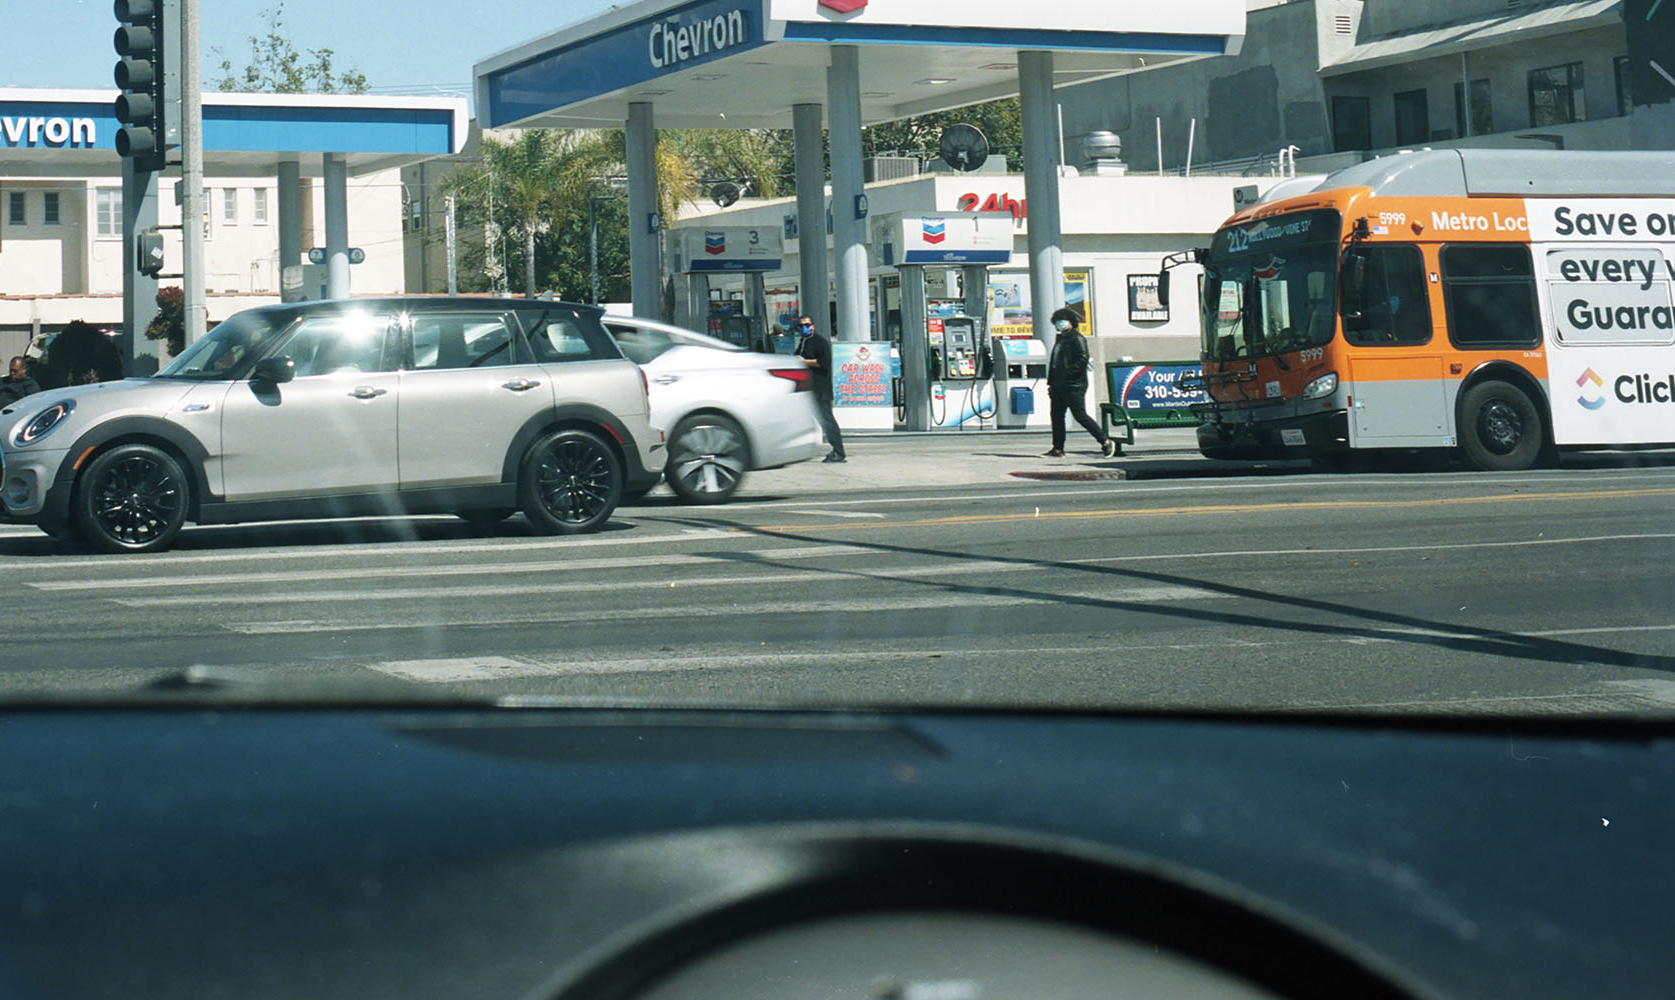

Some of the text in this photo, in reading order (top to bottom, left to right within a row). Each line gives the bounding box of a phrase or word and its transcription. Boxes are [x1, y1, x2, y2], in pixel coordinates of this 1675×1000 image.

[650, 8, 742, 68] Chevron
[1379, 212, 1405, 225] 5999
[1432, 212, 1488, 231] Metro
[1555, 207, 1638, 237] Save
[748, 230, 759, 245] 3
[1227, 229, 1248, 252] 212
[1560, 258, 1656, 291] every
[1567, 299, 1675, 330] Guara
[1300, 347, 1324, 363] 5999
[841, 363, 884, 374] CAR WASH
[1148, 370, 1175, 383] Your
[840, 384, 887, 395] THE STREET
